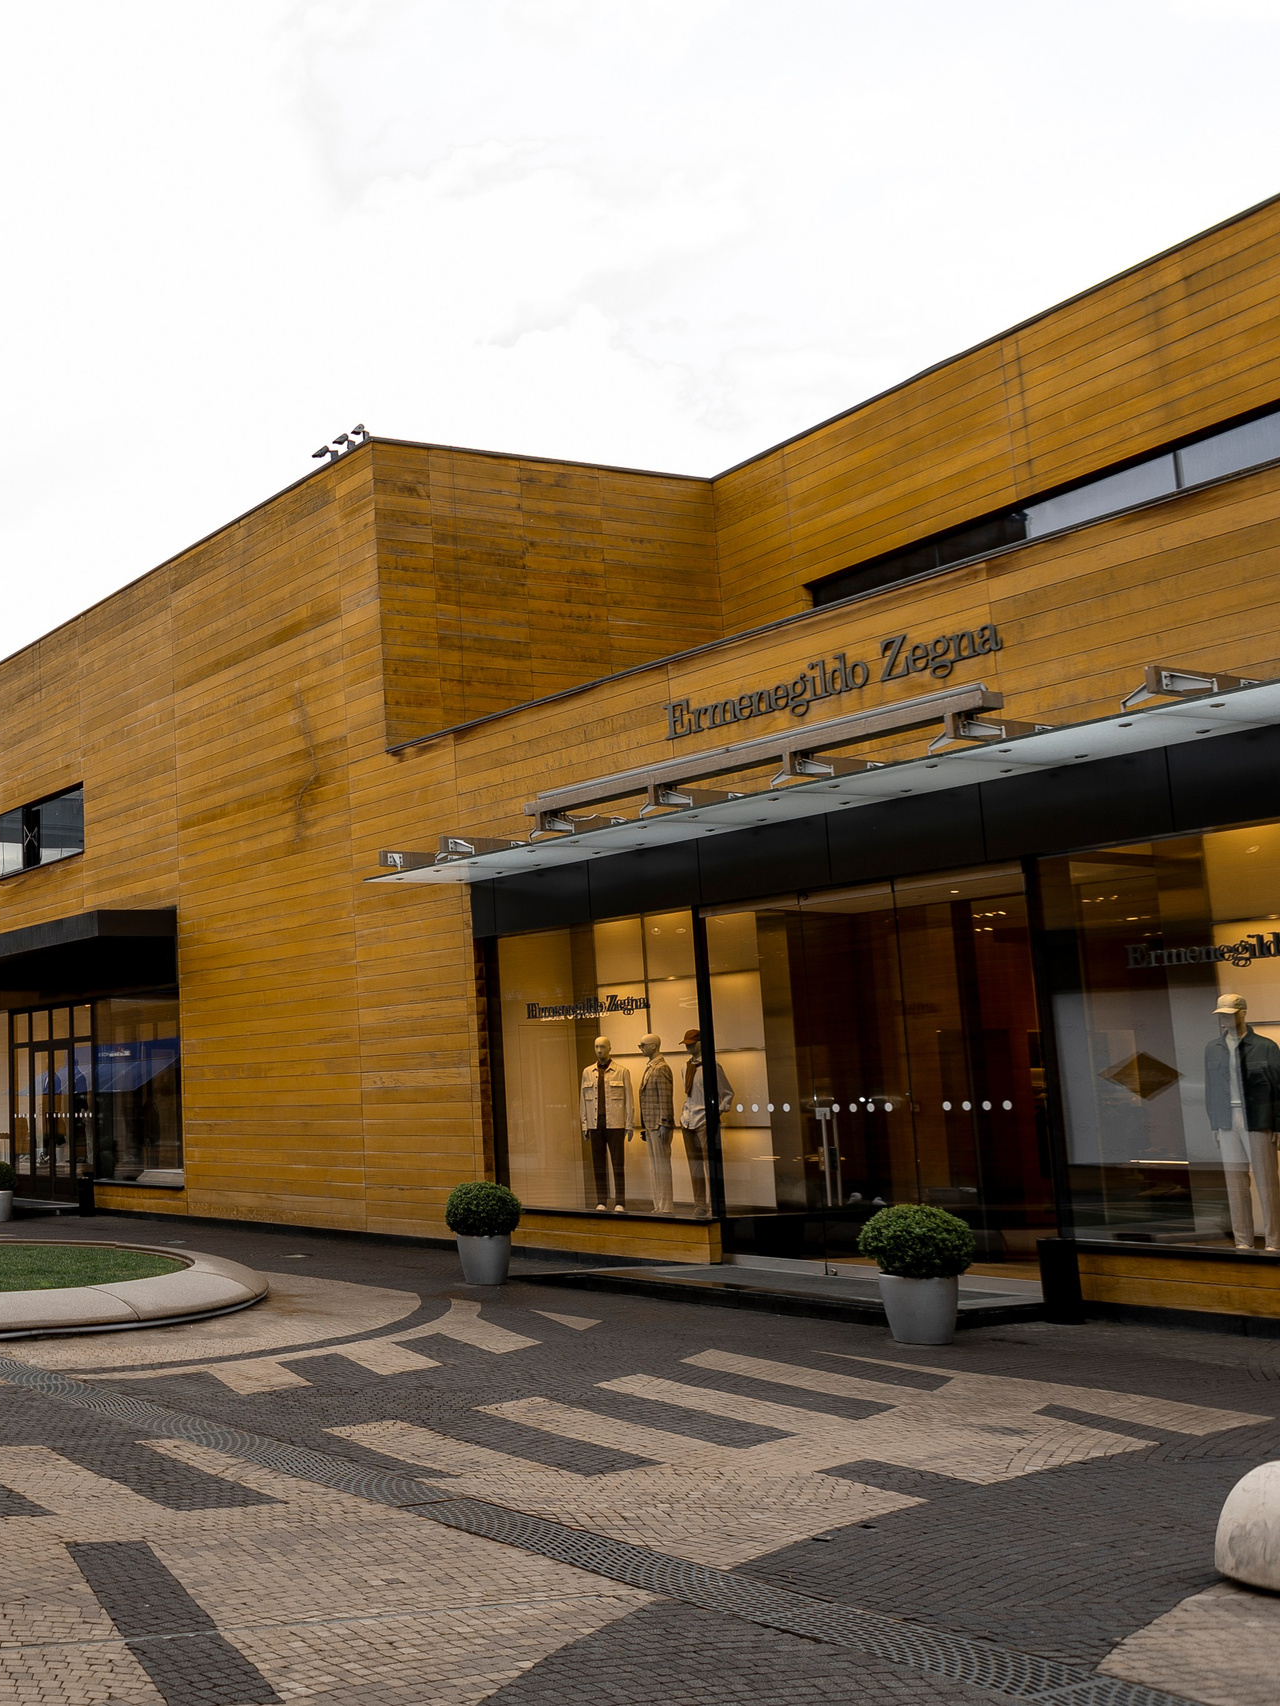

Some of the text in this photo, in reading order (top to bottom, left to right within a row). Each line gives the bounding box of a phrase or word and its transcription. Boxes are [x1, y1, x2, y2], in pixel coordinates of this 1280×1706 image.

[663, 623, 1002, 740] Ermenegildo Zegna
[605, 994, 651, 1015] Zegna
